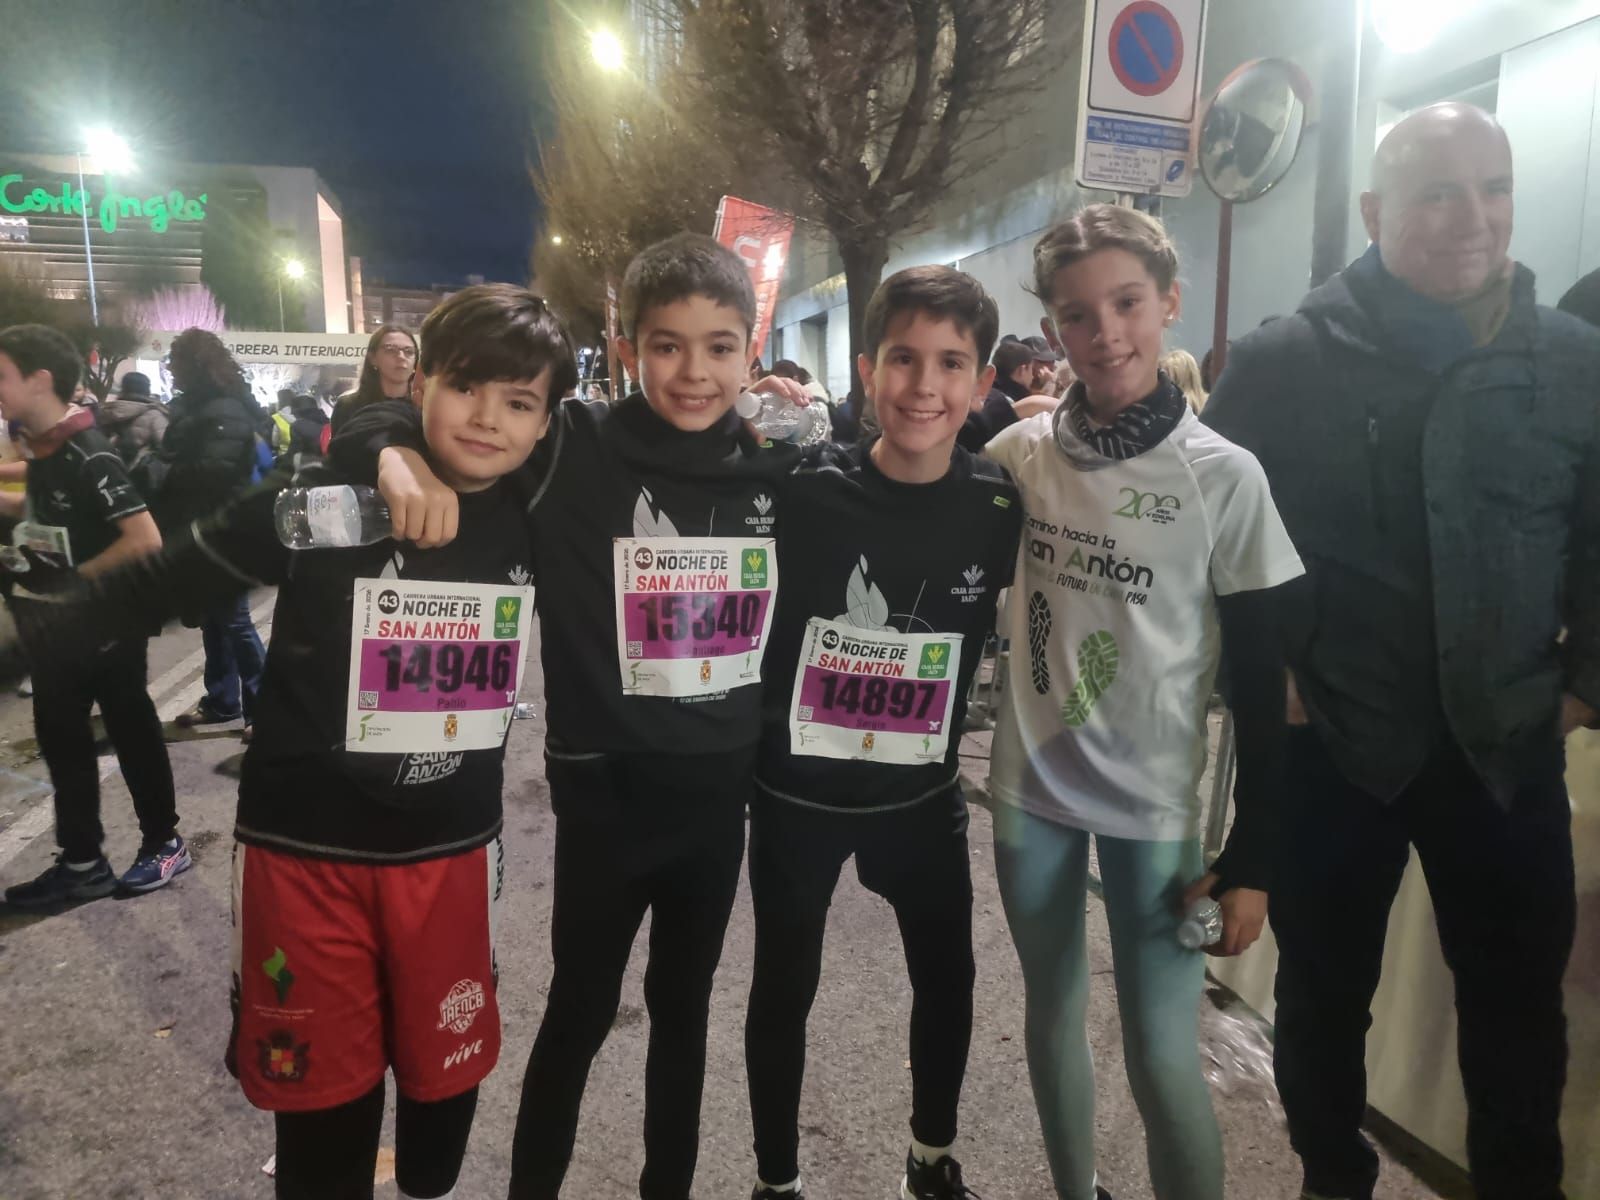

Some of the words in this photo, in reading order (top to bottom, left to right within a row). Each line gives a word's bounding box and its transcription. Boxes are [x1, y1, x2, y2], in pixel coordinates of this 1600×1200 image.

[228, 344, 278, 355] ARRERA
[1062, 525, 1099, 546] hacia
[1103, 534, 1116, 549] la
[635, 553, 652, 564] 43
[656, 556, 706, 570] NOCHE
[710, 556, 728, 570] DE
[1027, 538, 1055, 565] an
[1065, 545, 1154, 588] Antón
[636, 575, 670, 591] SAN
[674, 571, 728, 591] ANTÓN
[1056, 573, 1088, 592] FUTURO
[1126, 591, 1148, 605] PASO
[379, 594, 398, 608] 43
[402, 600, 458, 617] NOCHE
[461, 603, 481, 618] DE
[638, 593, 760, 642] 15340
[378, 620, 417, 639] SAN
[421, 618, 480, 640] ANTÓN
[823, 633, 838, 645] 43
[840, 641, 887, 659] NOCHE
[889, 647, 908, 660] DE
[379, 643, 512, 692] 14946
[818, 653, 850, 672] SAN
[852, 660, 904, 677] ANTÓN
[820, 674, 936, 720] 14897
[405, 752, 463, 779] ANTÓN
[409, 752, 448, 765] SAN
